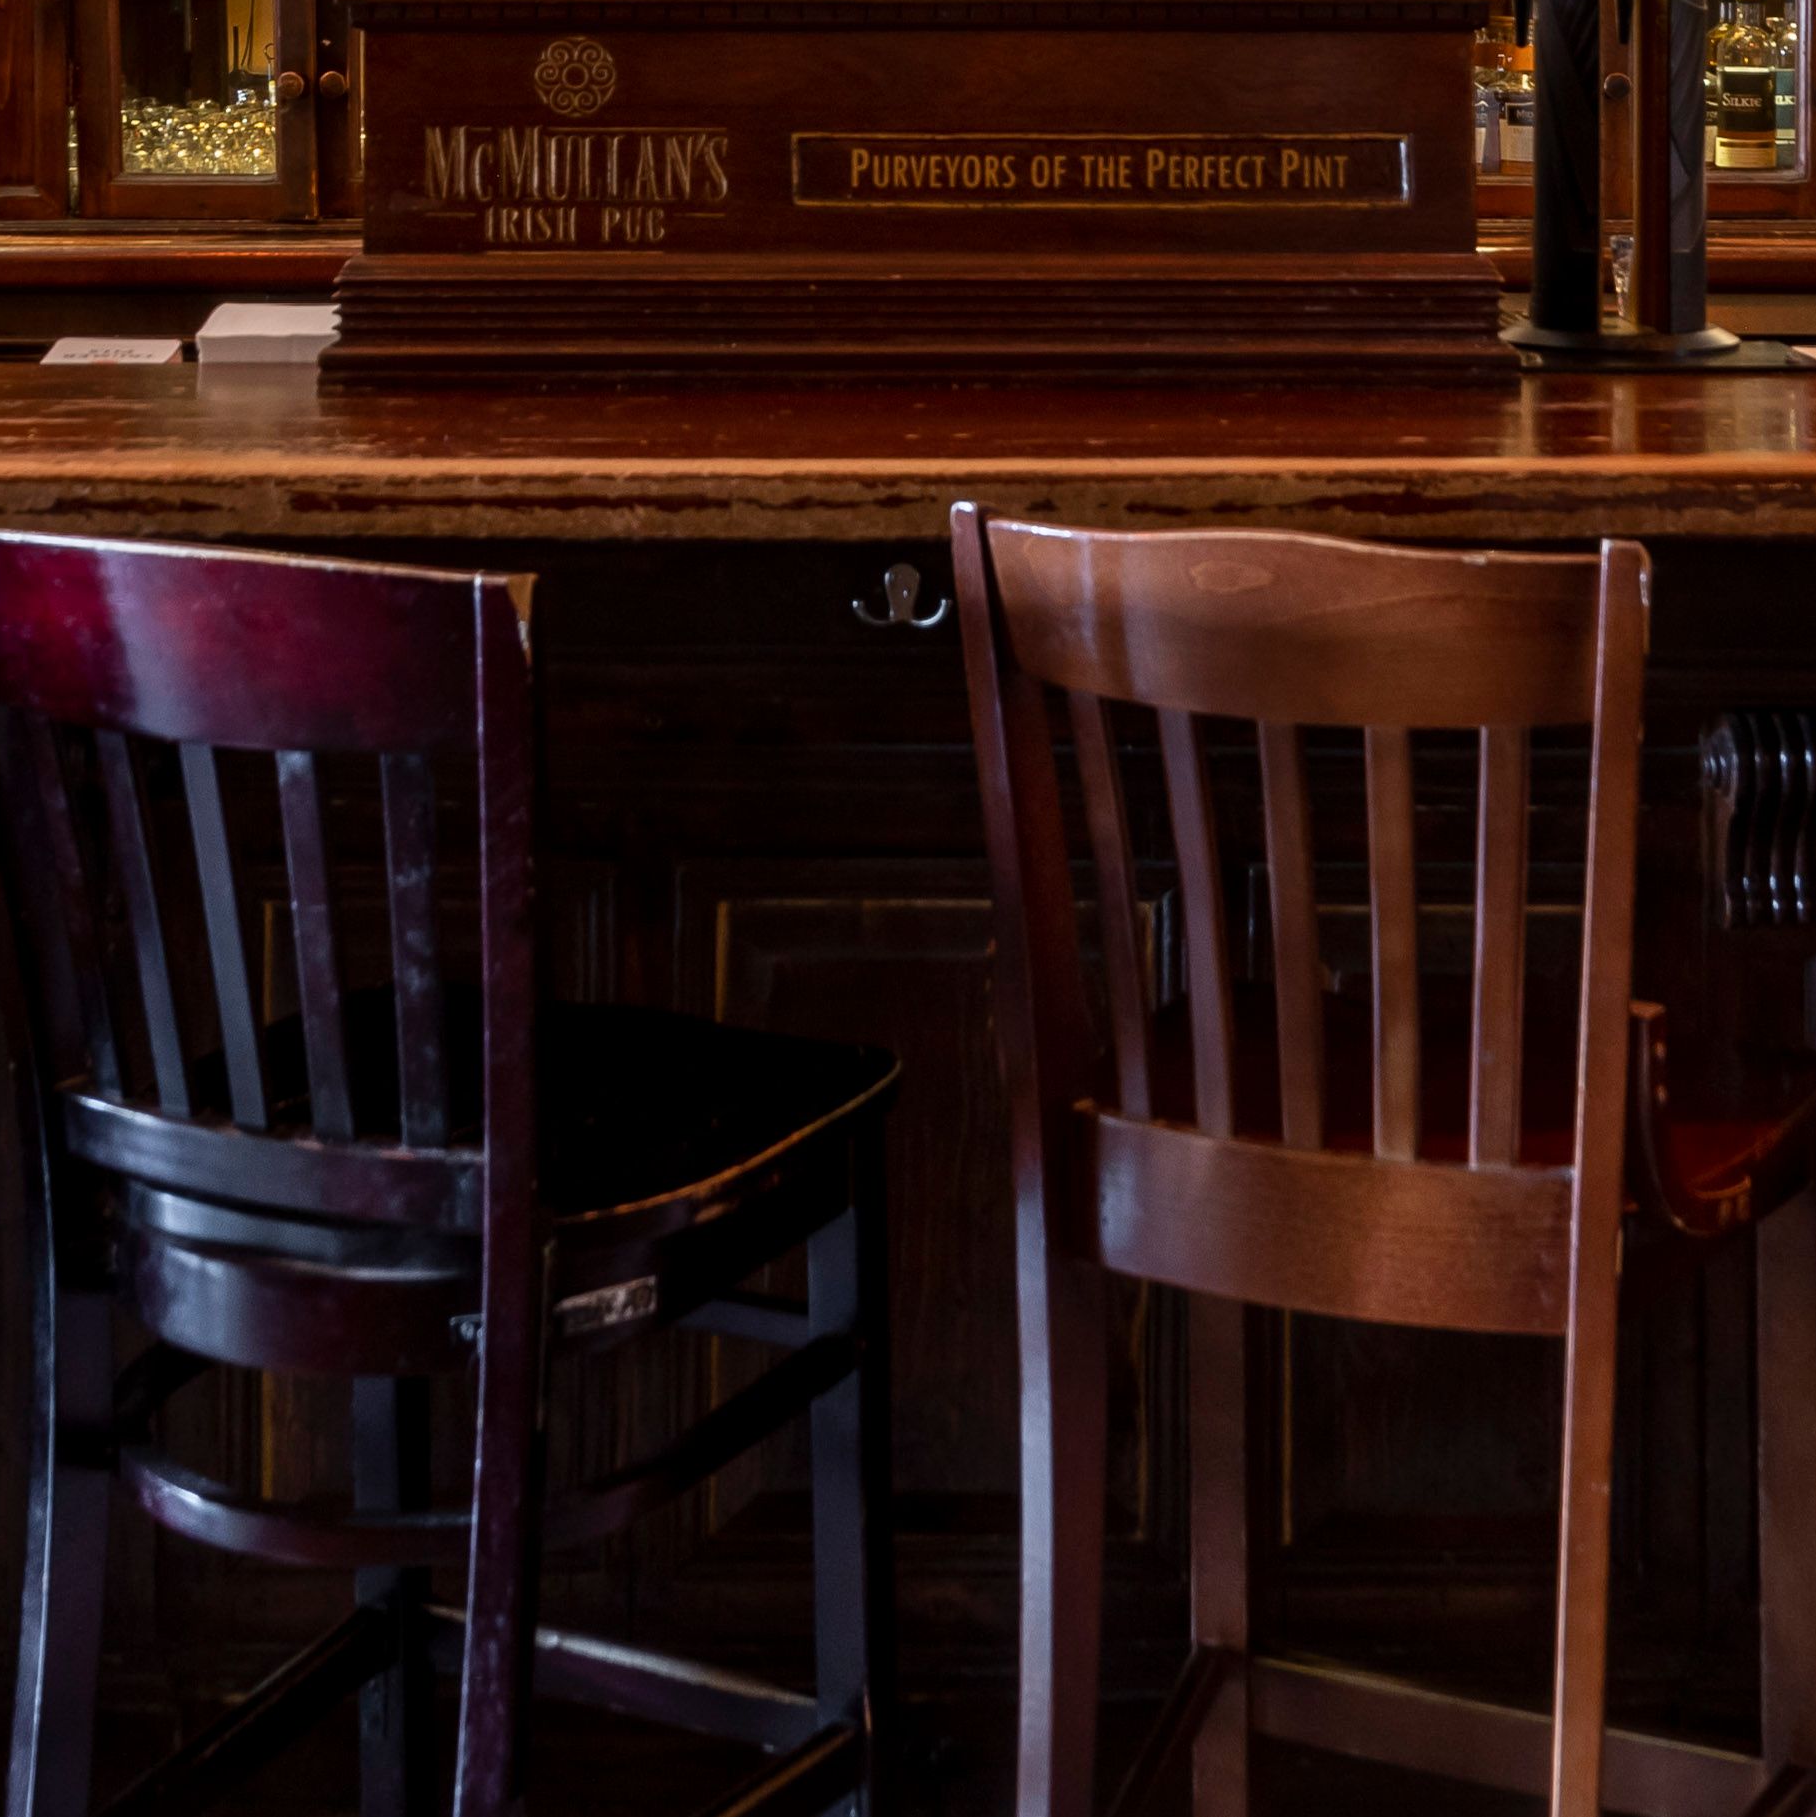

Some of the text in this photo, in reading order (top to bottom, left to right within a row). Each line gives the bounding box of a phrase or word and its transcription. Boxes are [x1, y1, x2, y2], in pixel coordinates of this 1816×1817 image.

[850, 149, 1349, 190] PURVEYORS OF THE PERFECT PINT
[485, 208, 667, 245] IRISH PUB
